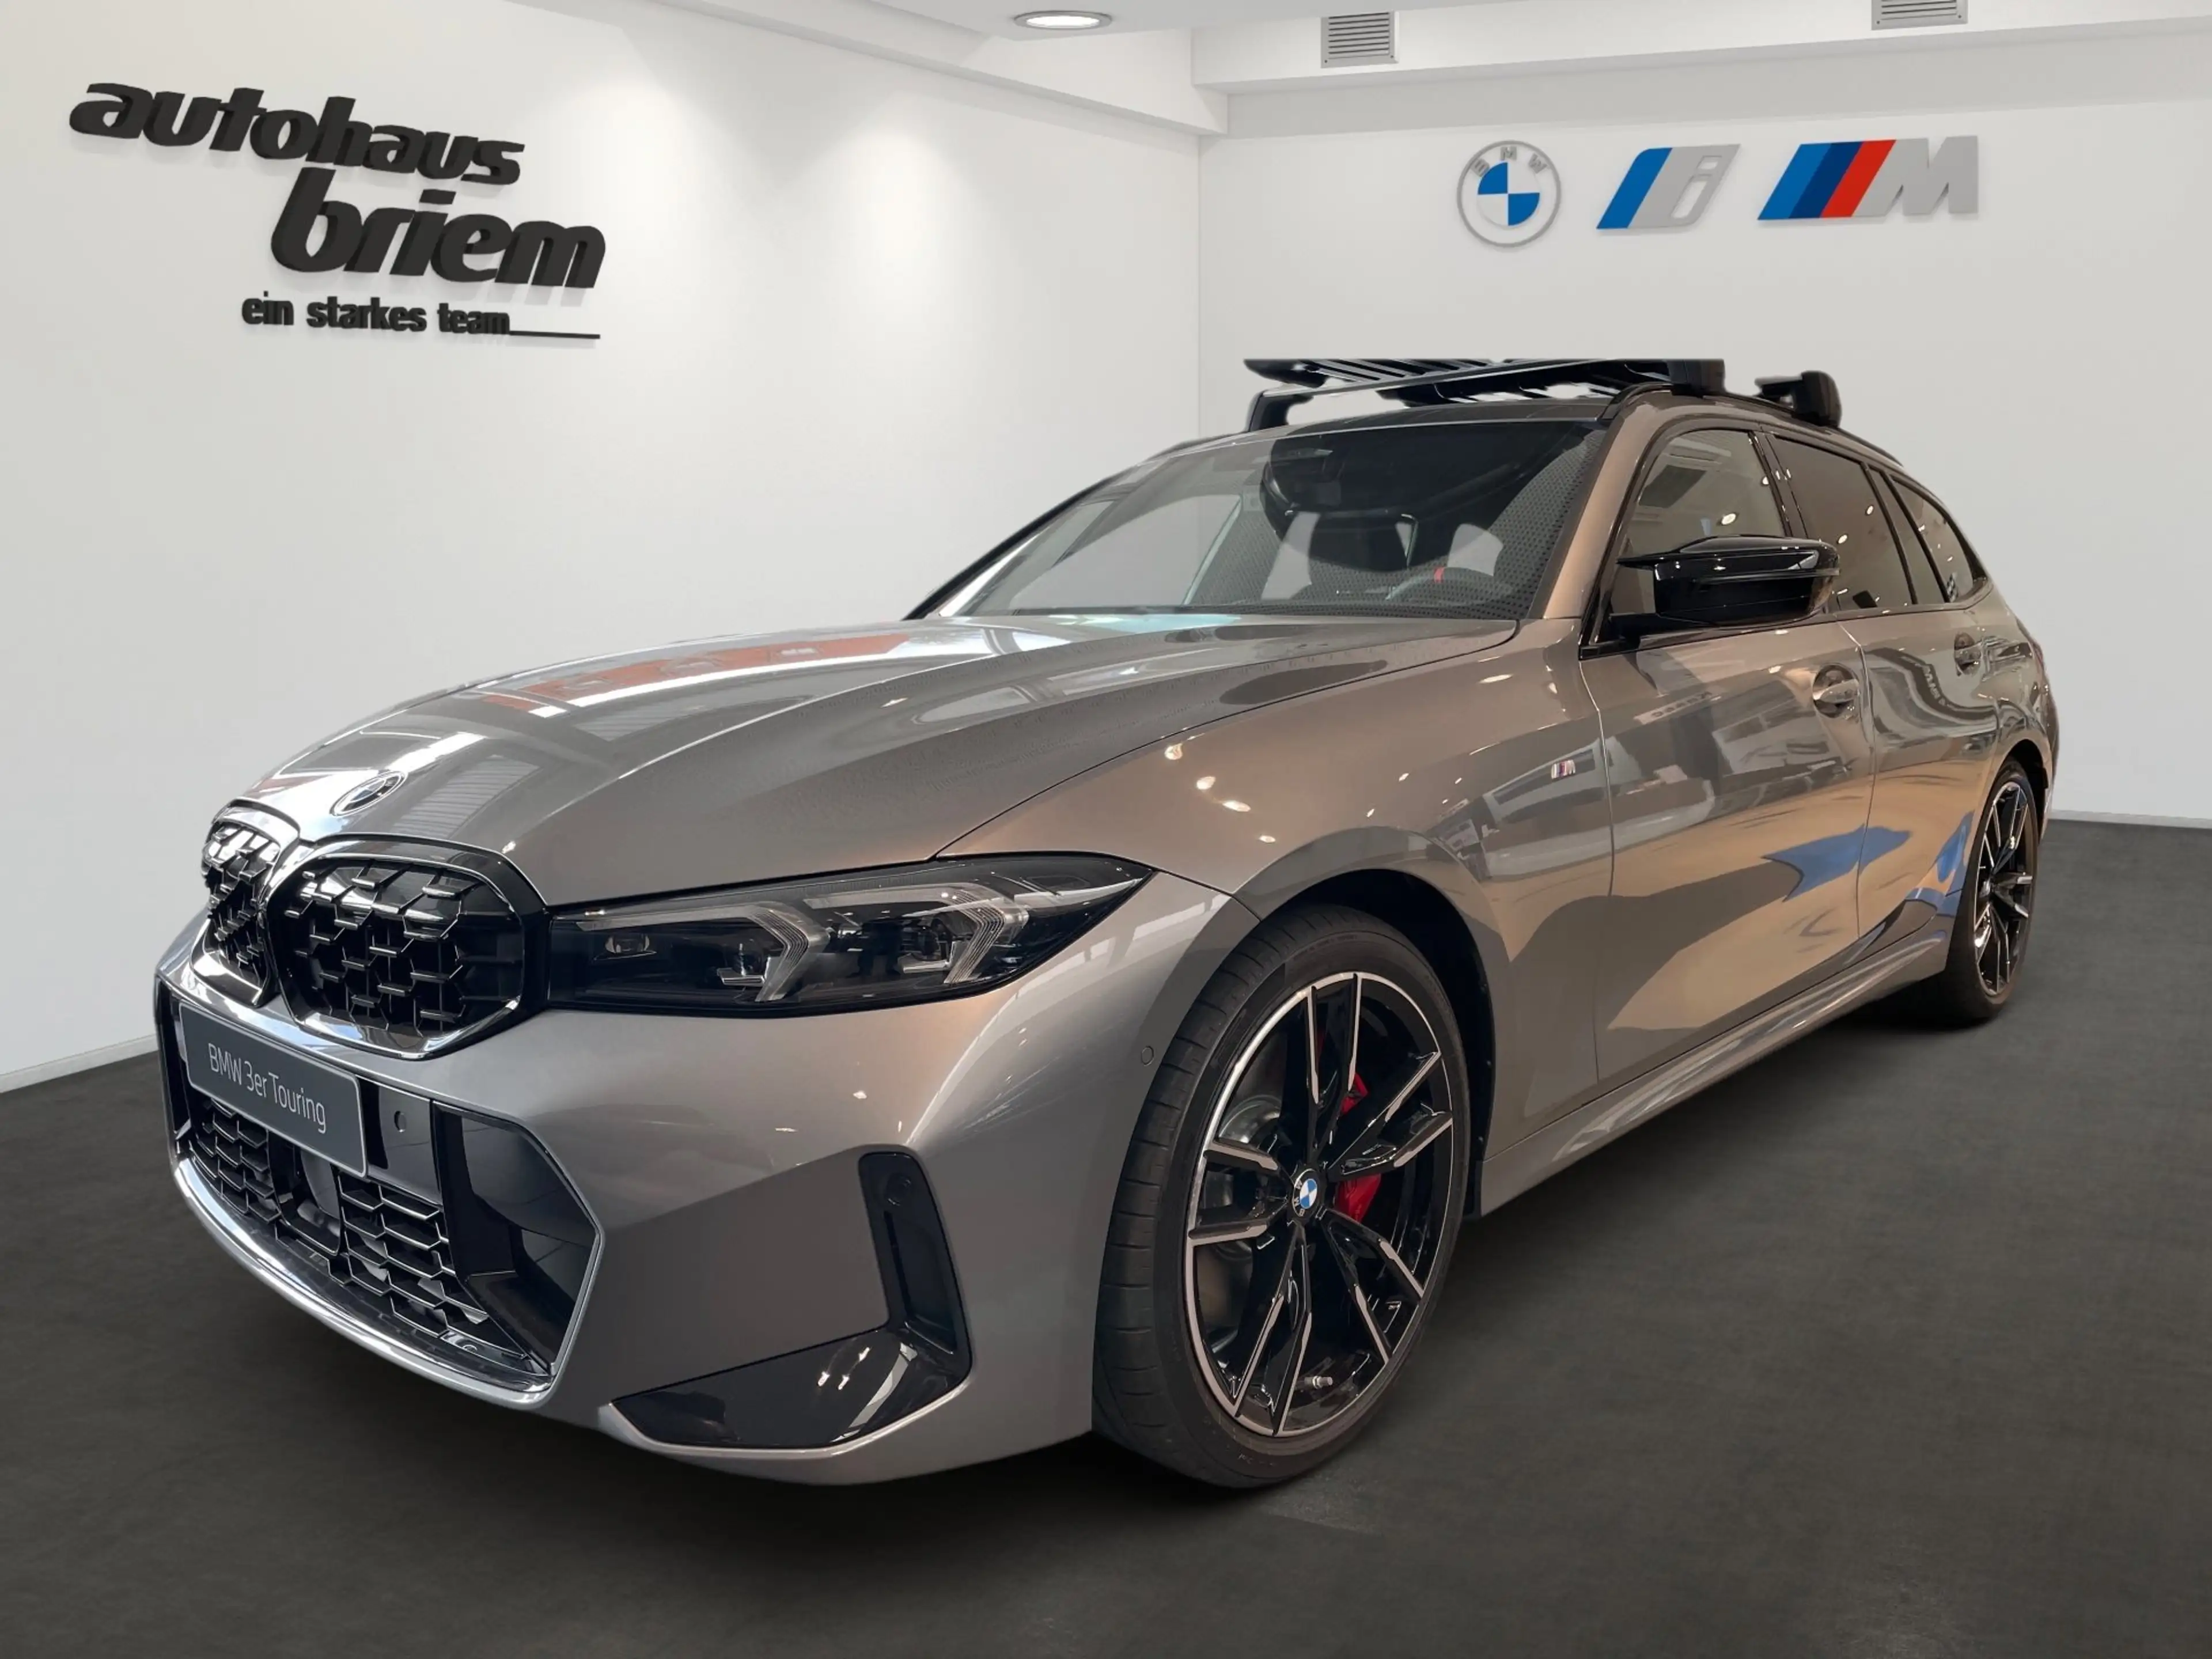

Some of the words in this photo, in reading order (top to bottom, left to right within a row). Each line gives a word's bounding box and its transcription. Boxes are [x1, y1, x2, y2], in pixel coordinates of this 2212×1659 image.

[69, 82, 525, 185] autohaus
[271, 166, 606, 289] briem
[241, 291, 294, 326] ein
[306, 296, 427, 332] starkes
[437, 302, 511, 336] team
[208, 1043, 242, 1085] BMW
[244, 1060, 267, 1097] 3er
[268, 1071, 327, 1134] Touring
